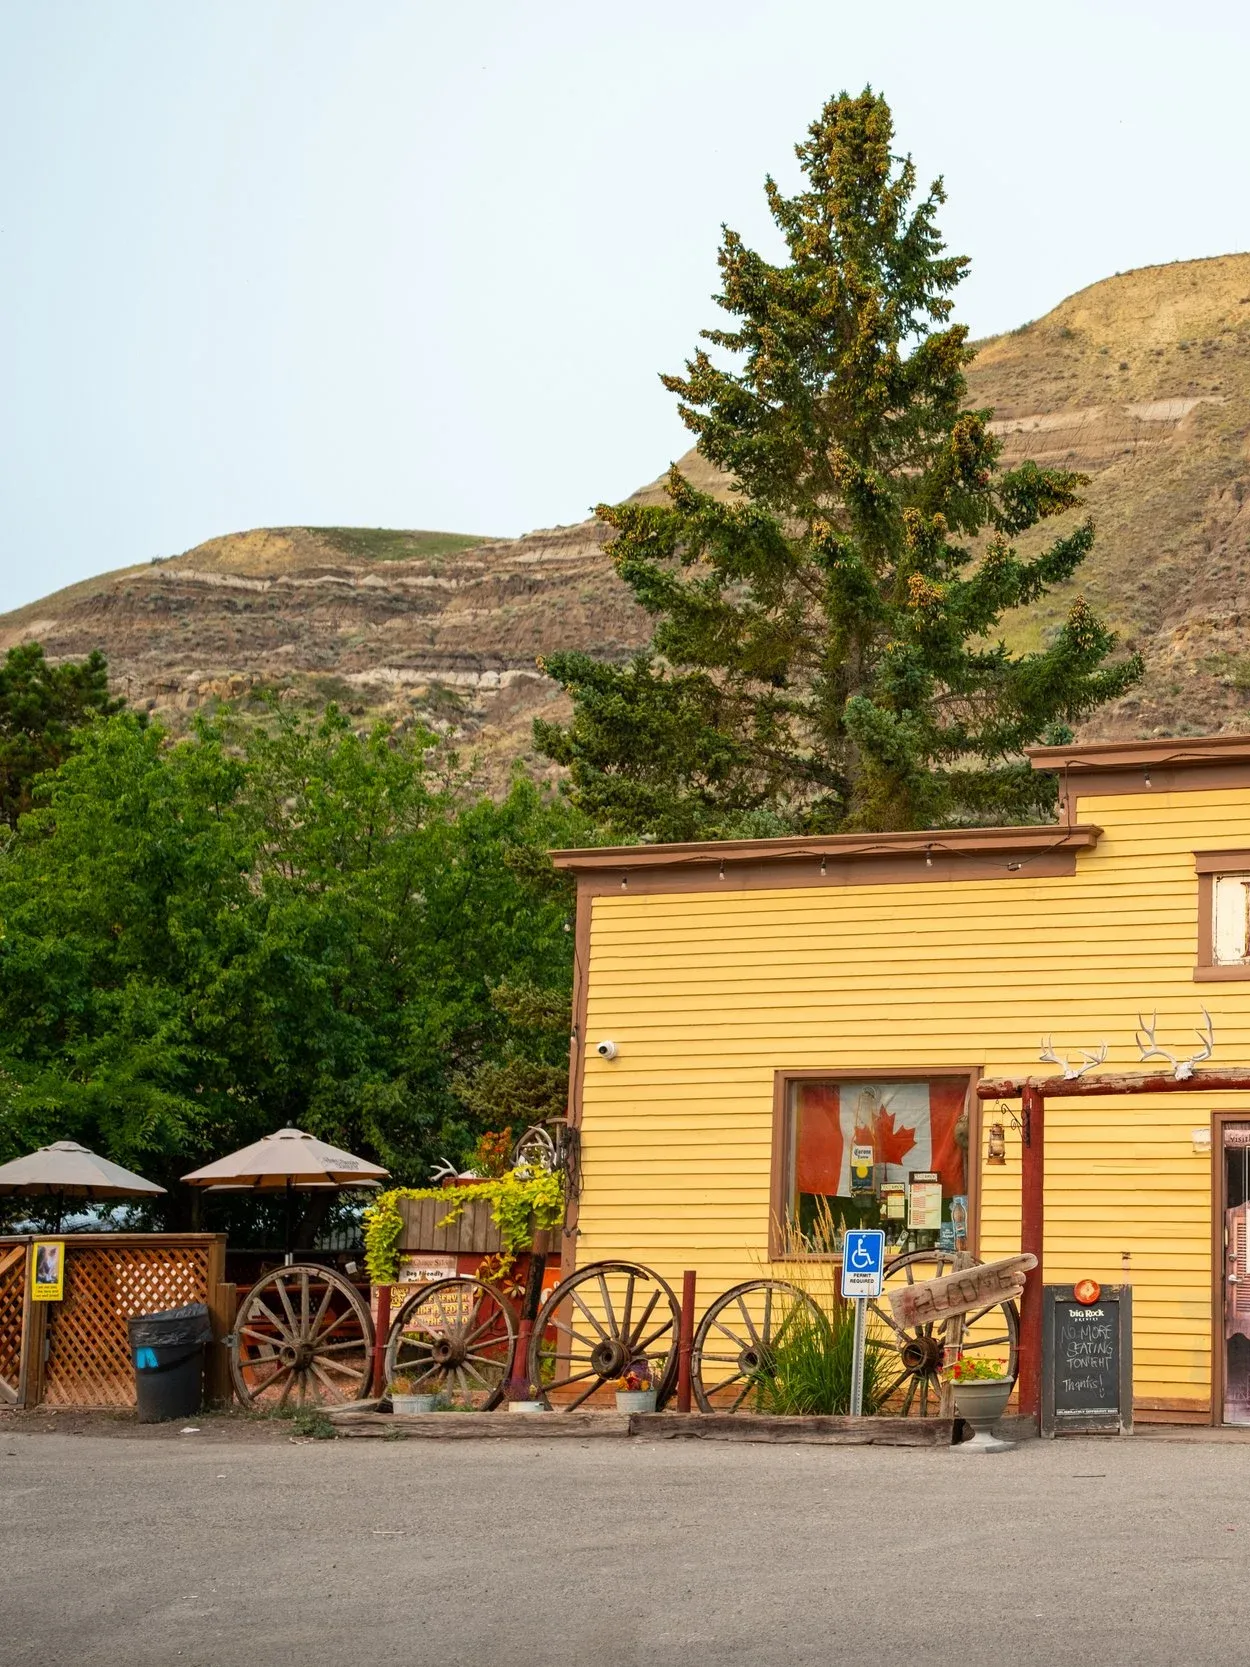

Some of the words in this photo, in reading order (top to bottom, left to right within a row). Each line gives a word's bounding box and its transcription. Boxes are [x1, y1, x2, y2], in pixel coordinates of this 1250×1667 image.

[1061, 1325, 1076, 1343] NO
[1081, 1324, 1112, 1341] MORE
[1066, 1341, 1113, 1359] SEATING
[1066, 1356, 1112, 1371] TONIGHT
